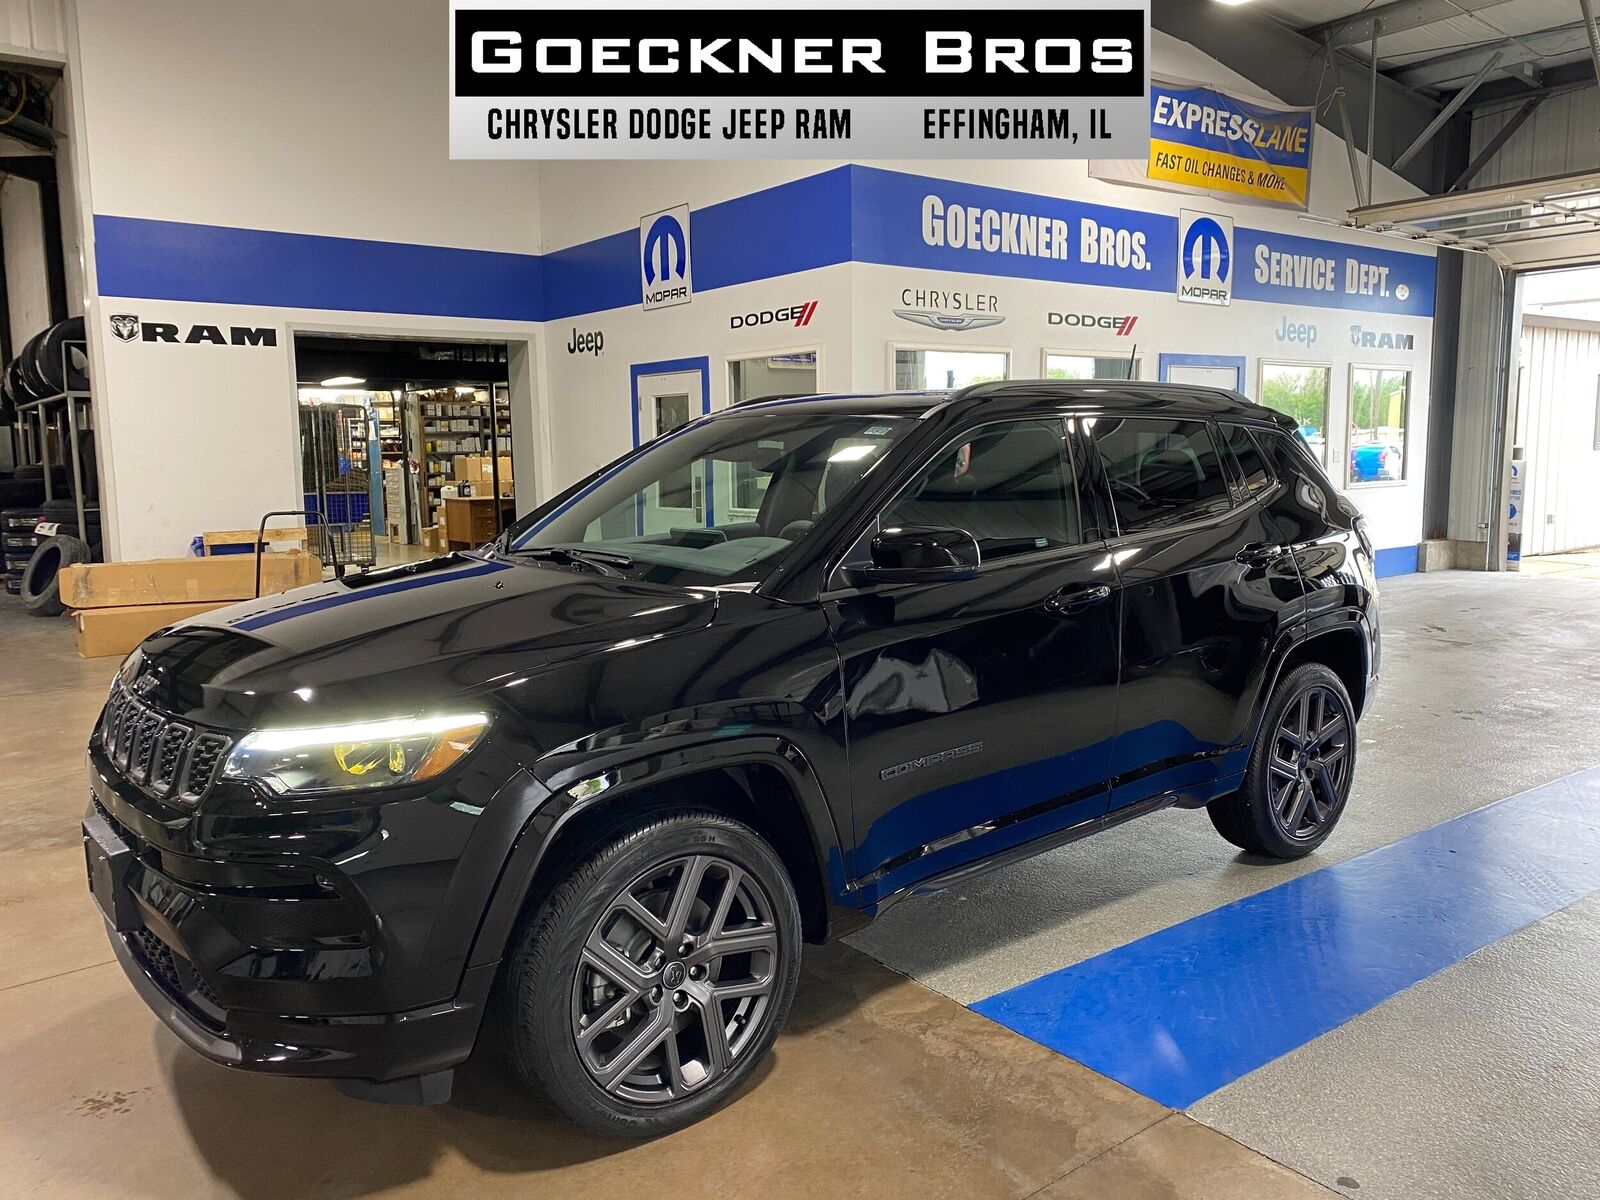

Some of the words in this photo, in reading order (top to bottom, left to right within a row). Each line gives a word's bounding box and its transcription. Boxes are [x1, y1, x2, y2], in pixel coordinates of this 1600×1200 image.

[1155, 152, 1183, 171] FAST
[1184, 157, 1199, 175] OIL
[1202, 161, 1246, 183] CHANGES
[1247, 171, 1254, 185] &
[1257, 172, 1285, 190] MORE
[922, 195, 1069, 260] GOECKNER
[1080, 218, 1151, 271] BROS.
[1254, 244, 1336, 292] SERVICE
[1345, 258, 1390, 298] DEPT.
[646, 286, 687, 305] MOPAR
[902, 288, 998, 312] CHRYSLER
[1181, 285, 1227, 301] MOPAR
[730, 305, 805, 329] DODGE
[1048, 312, 1126, 329] DODGE
[140, 322, 278, 347] RAM
[567, 327, 604, 357] Jeep
[1275, 316, 1317, 348] Jeep
[1361, 331, 1414, 350] RAM
[880, 740, 984, 780] COMPASS
